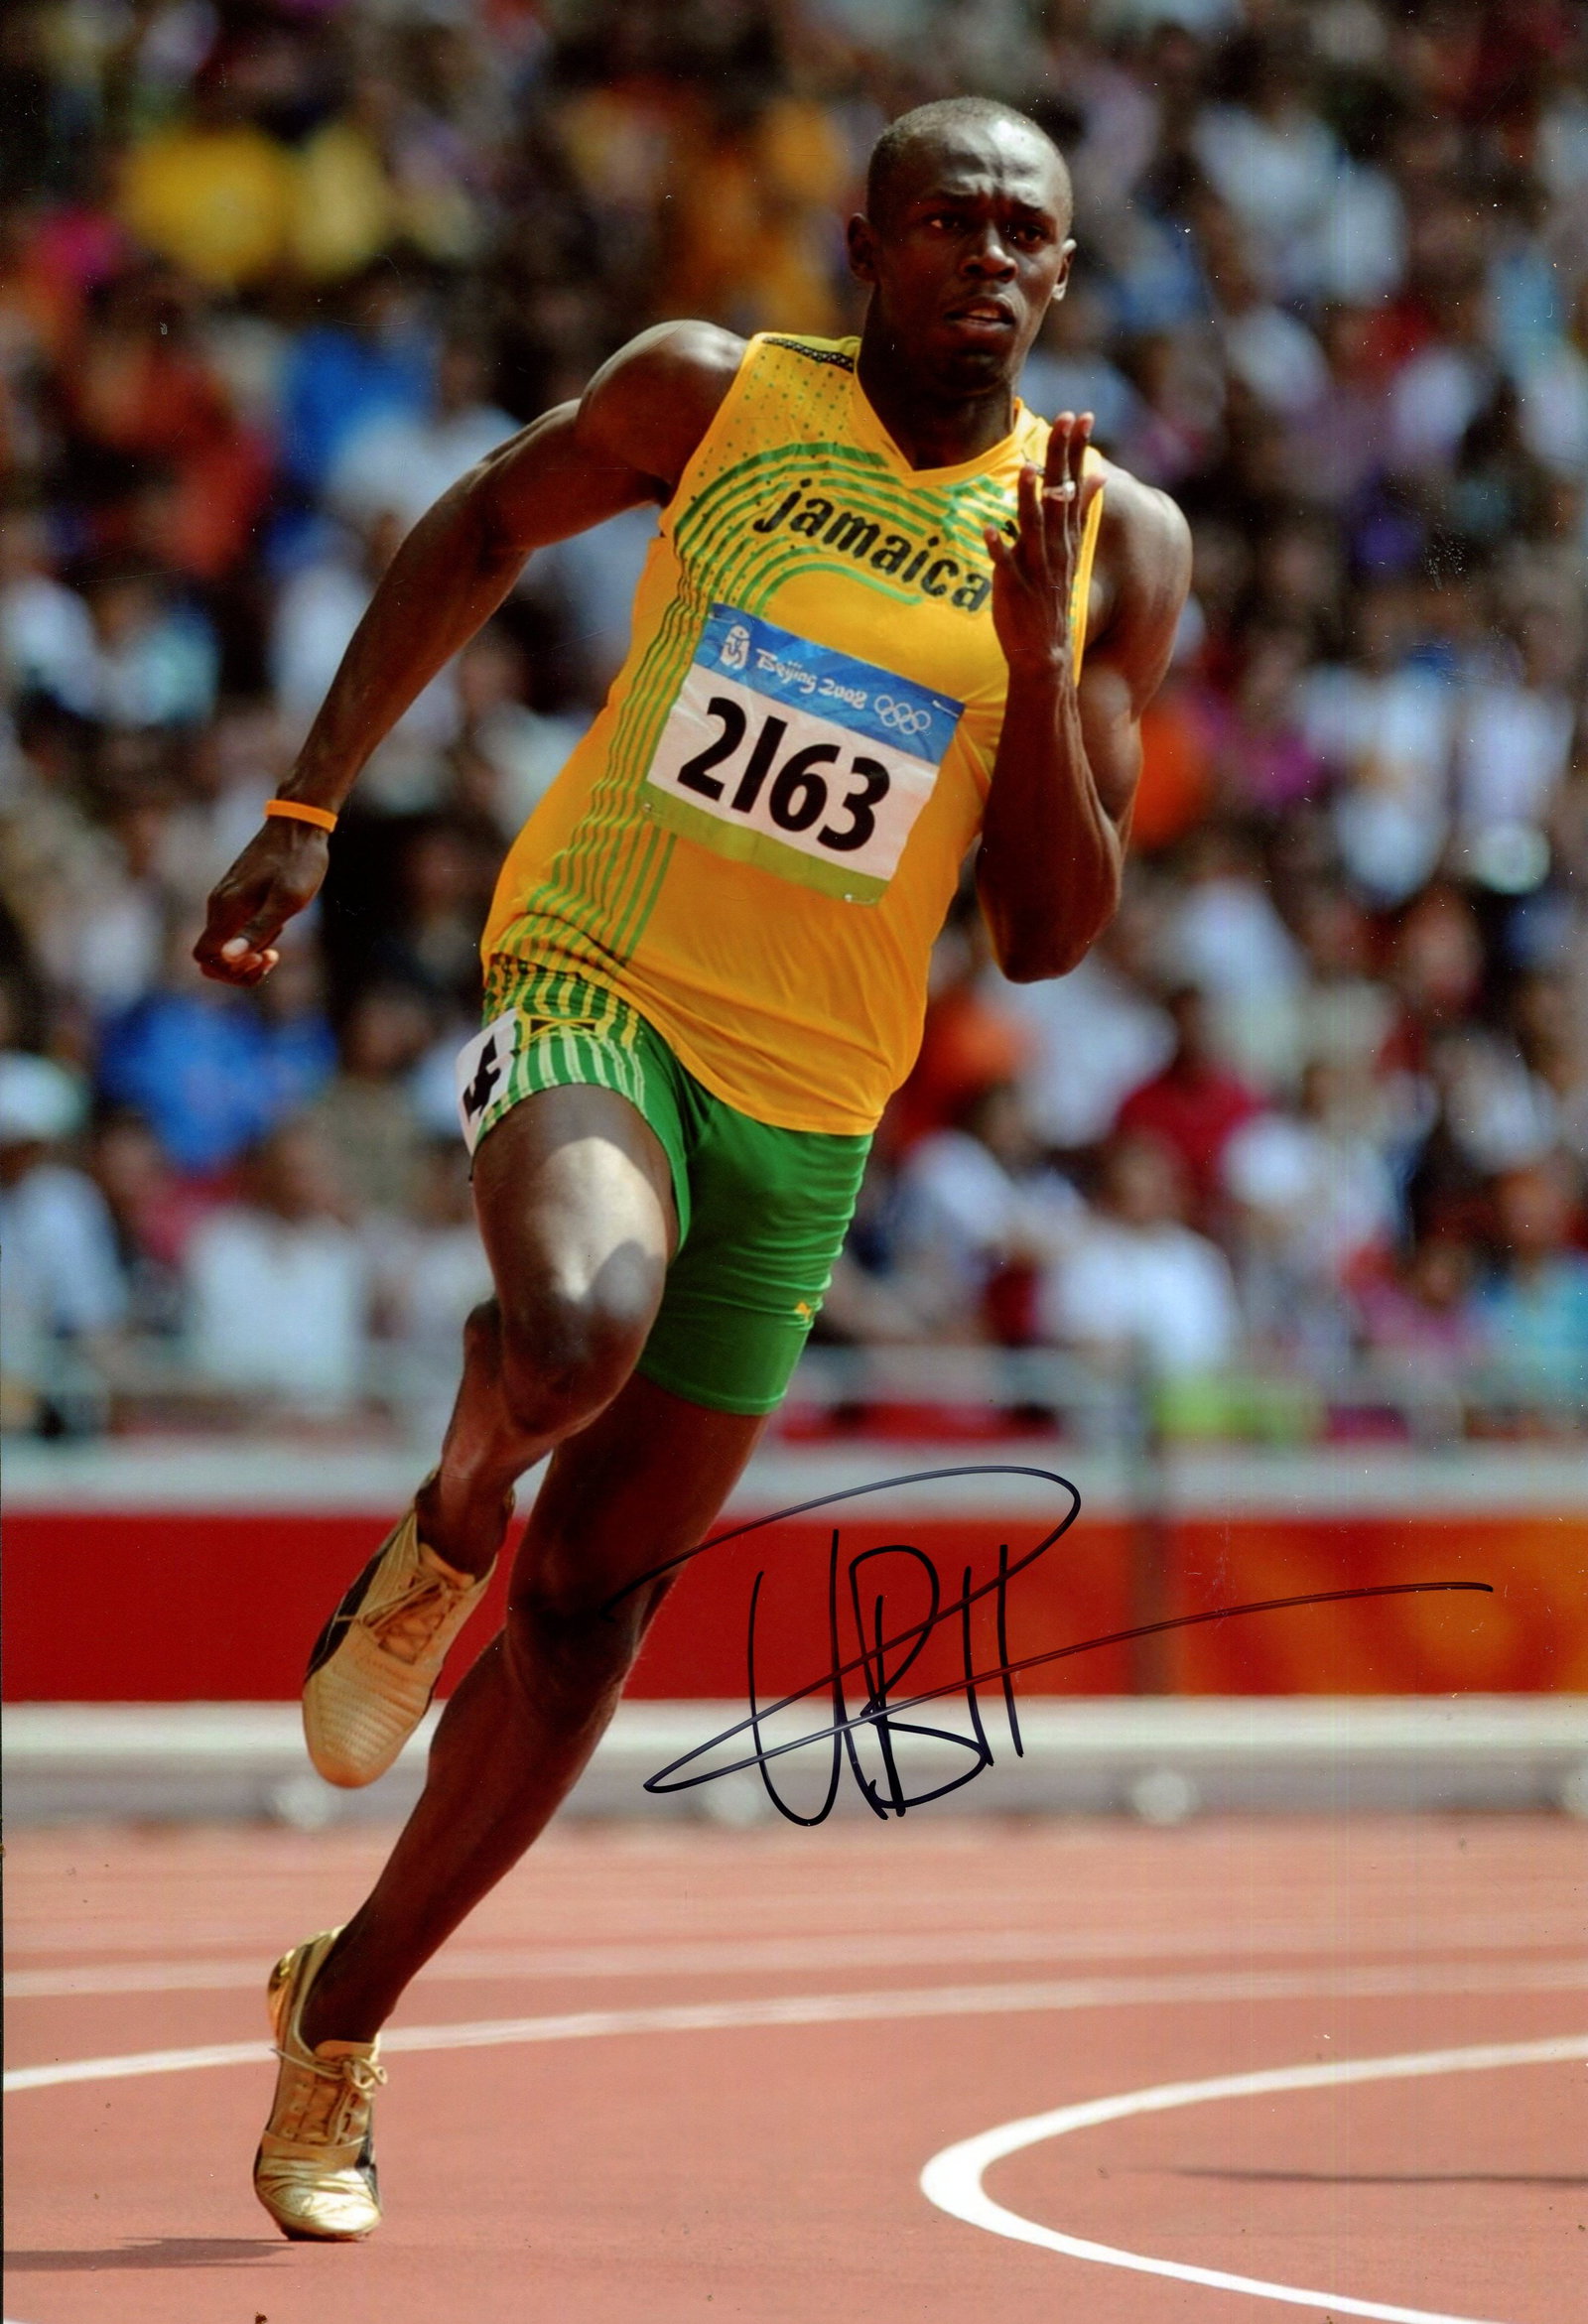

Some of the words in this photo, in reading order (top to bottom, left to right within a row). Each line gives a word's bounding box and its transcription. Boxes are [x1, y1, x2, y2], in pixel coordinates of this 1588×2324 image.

[752, 477, 992, 612] jamaica
[755, 648, 818, 694] Beijing
[818, 678, 867, 710] 2008
[676, 696, 891, 852] 2163
[463, 1034, 502, 1124] 4
